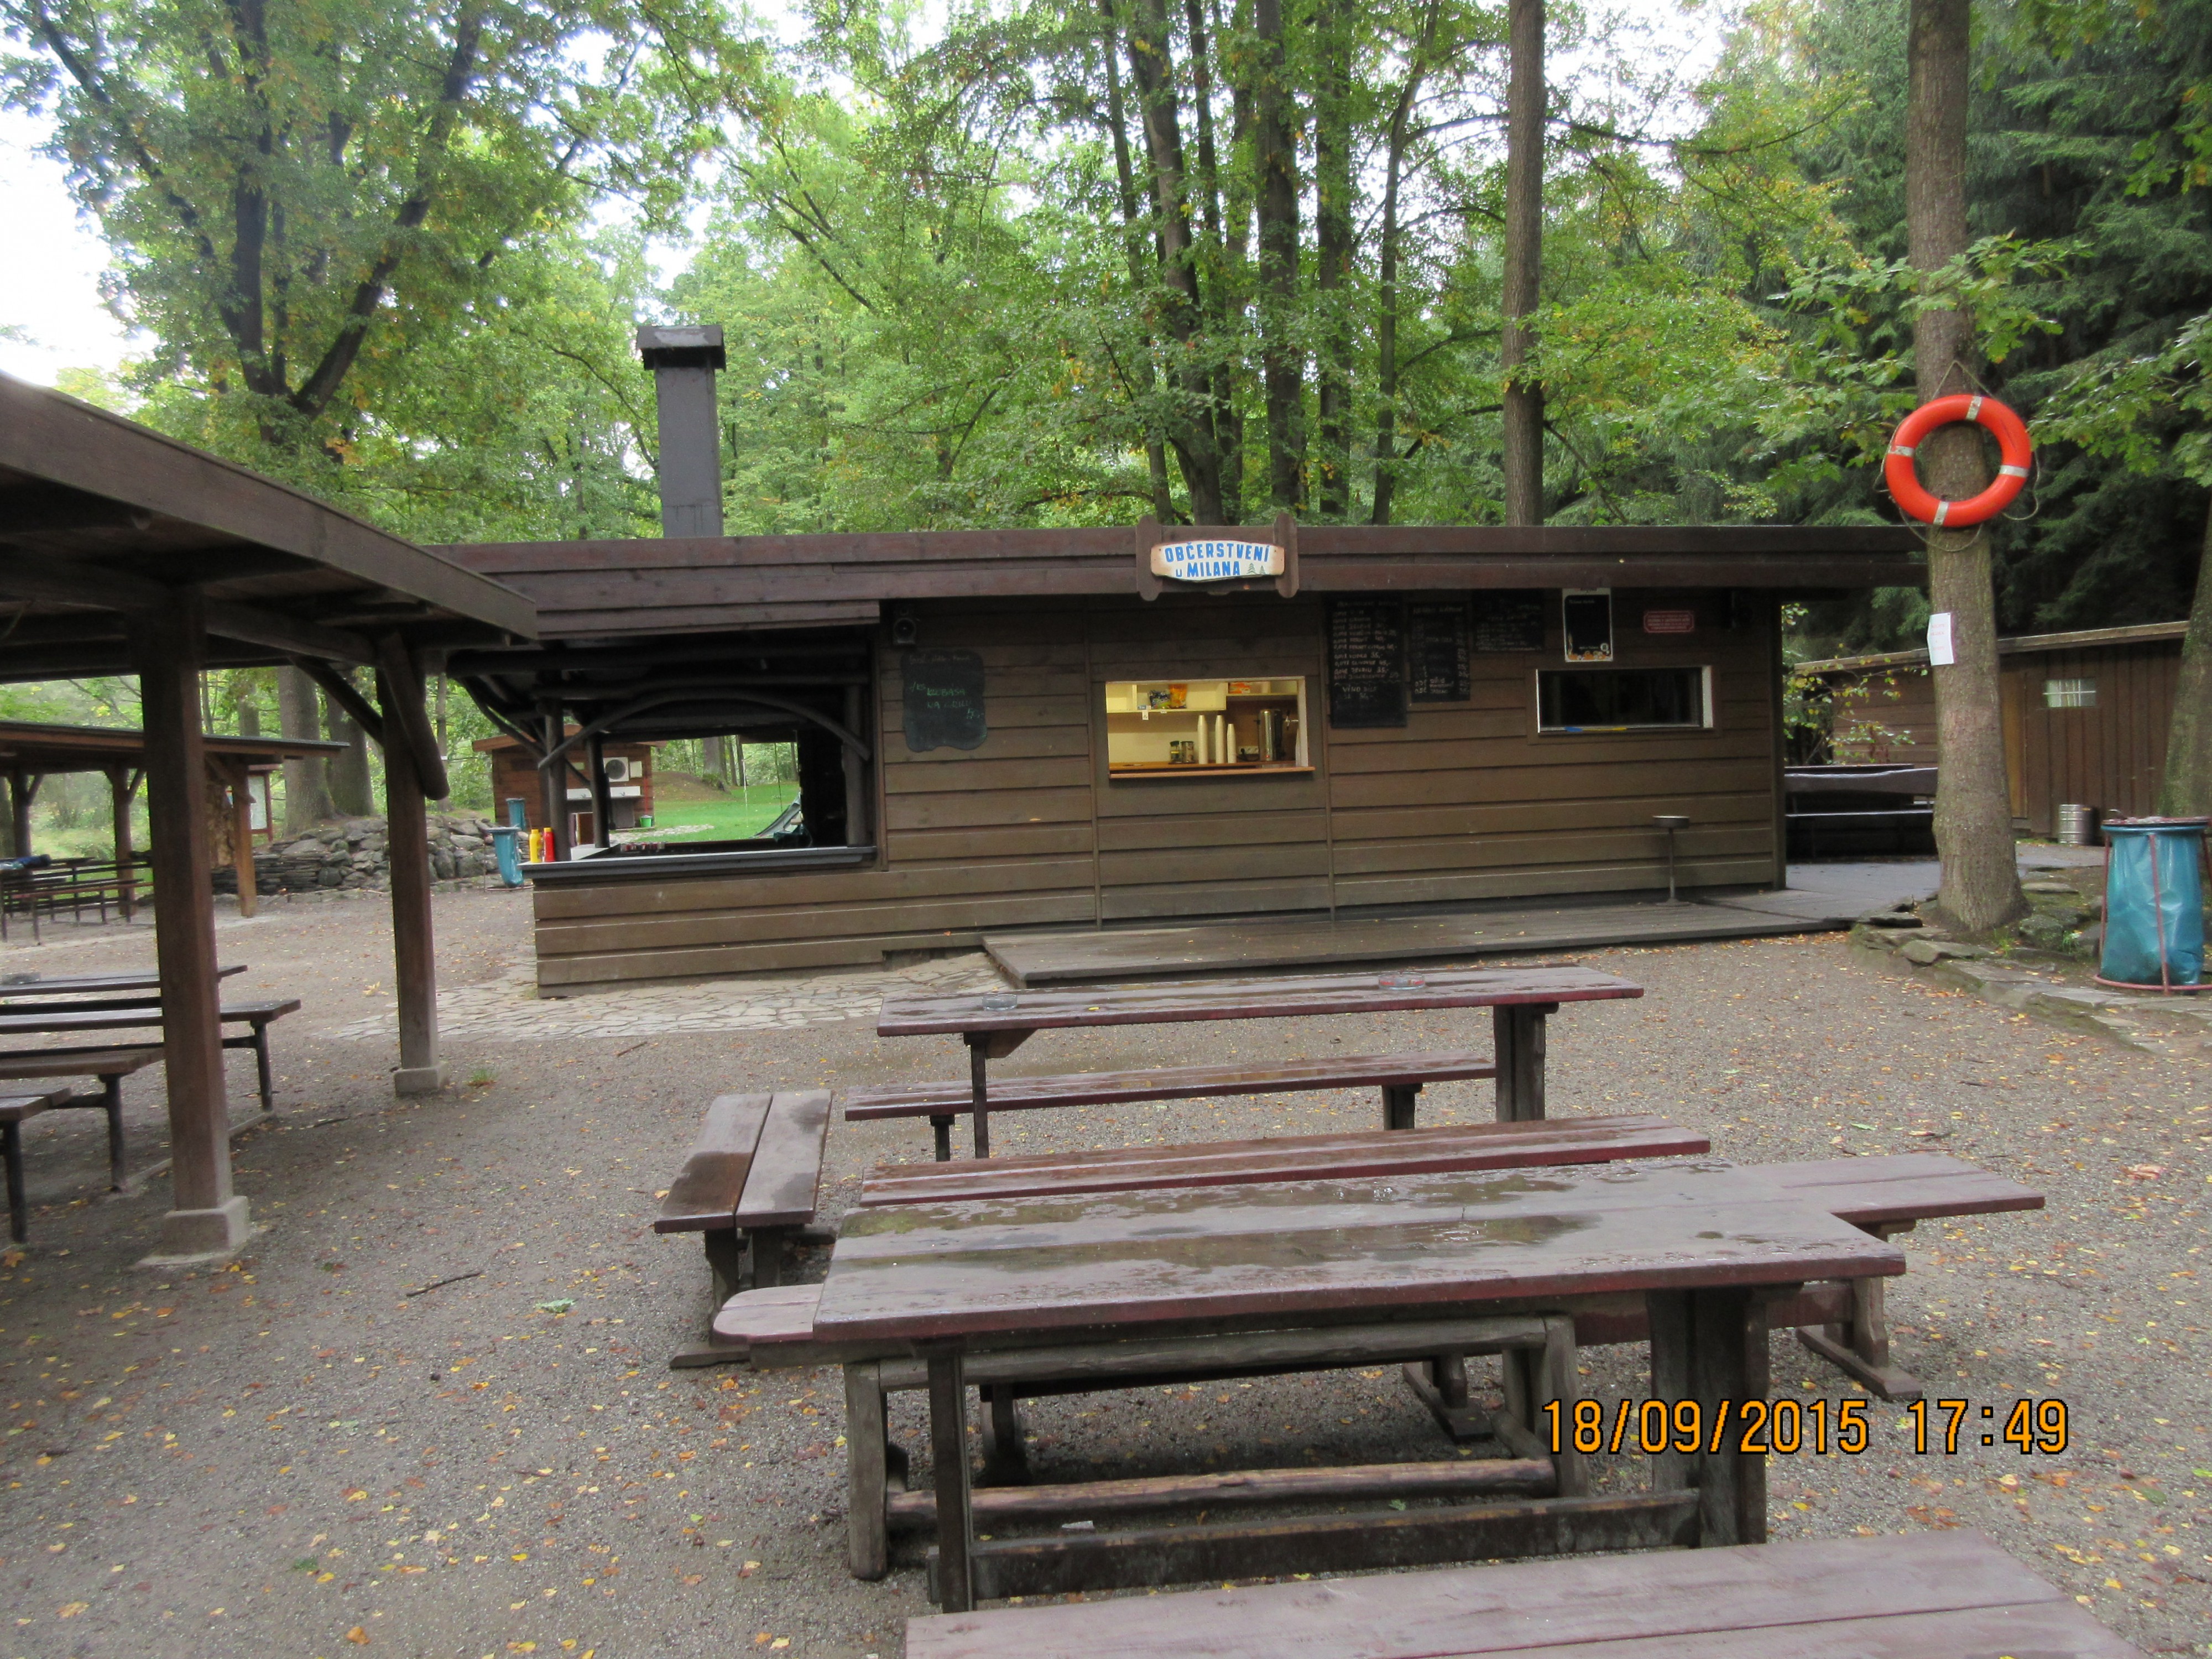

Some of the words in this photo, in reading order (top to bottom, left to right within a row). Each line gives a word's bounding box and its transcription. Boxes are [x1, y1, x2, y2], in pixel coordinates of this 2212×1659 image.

[1164, 542, 1270, 563] OBČERSTVENÍ
[1187, 561, 1240, 577] MILANA
[1342, 683, 1361, 692] VÍNO
